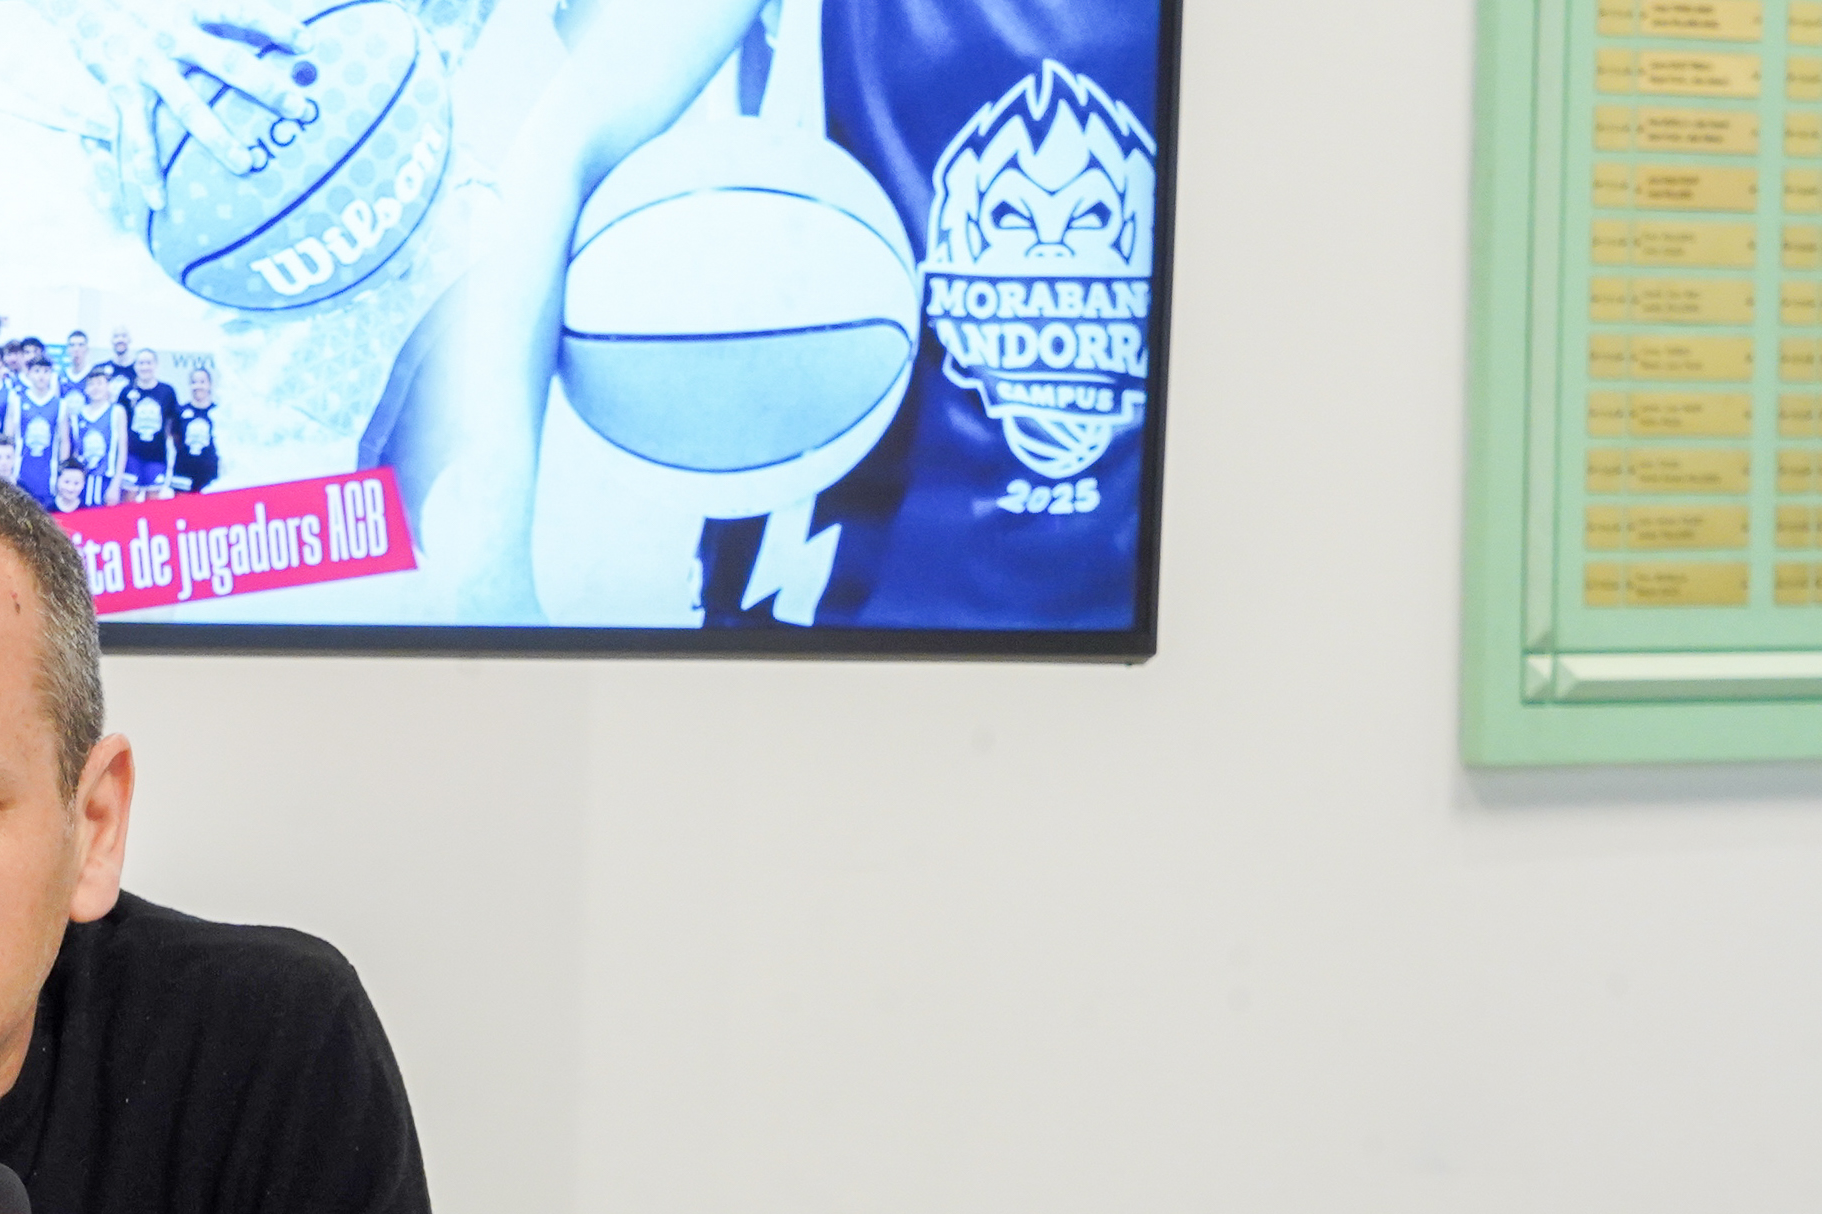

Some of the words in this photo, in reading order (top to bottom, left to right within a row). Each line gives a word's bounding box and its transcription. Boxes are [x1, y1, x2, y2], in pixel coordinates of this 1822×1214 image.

[250, 123, 444, 296] Wilson
[935, 318, 1149, 379] ANDORR
[129, 517, 173, 590] de
[175, 501, 323, 601] jugadors
[324, 478, 389, 563] ACB
[996, 477, 1101, 515] 2025
